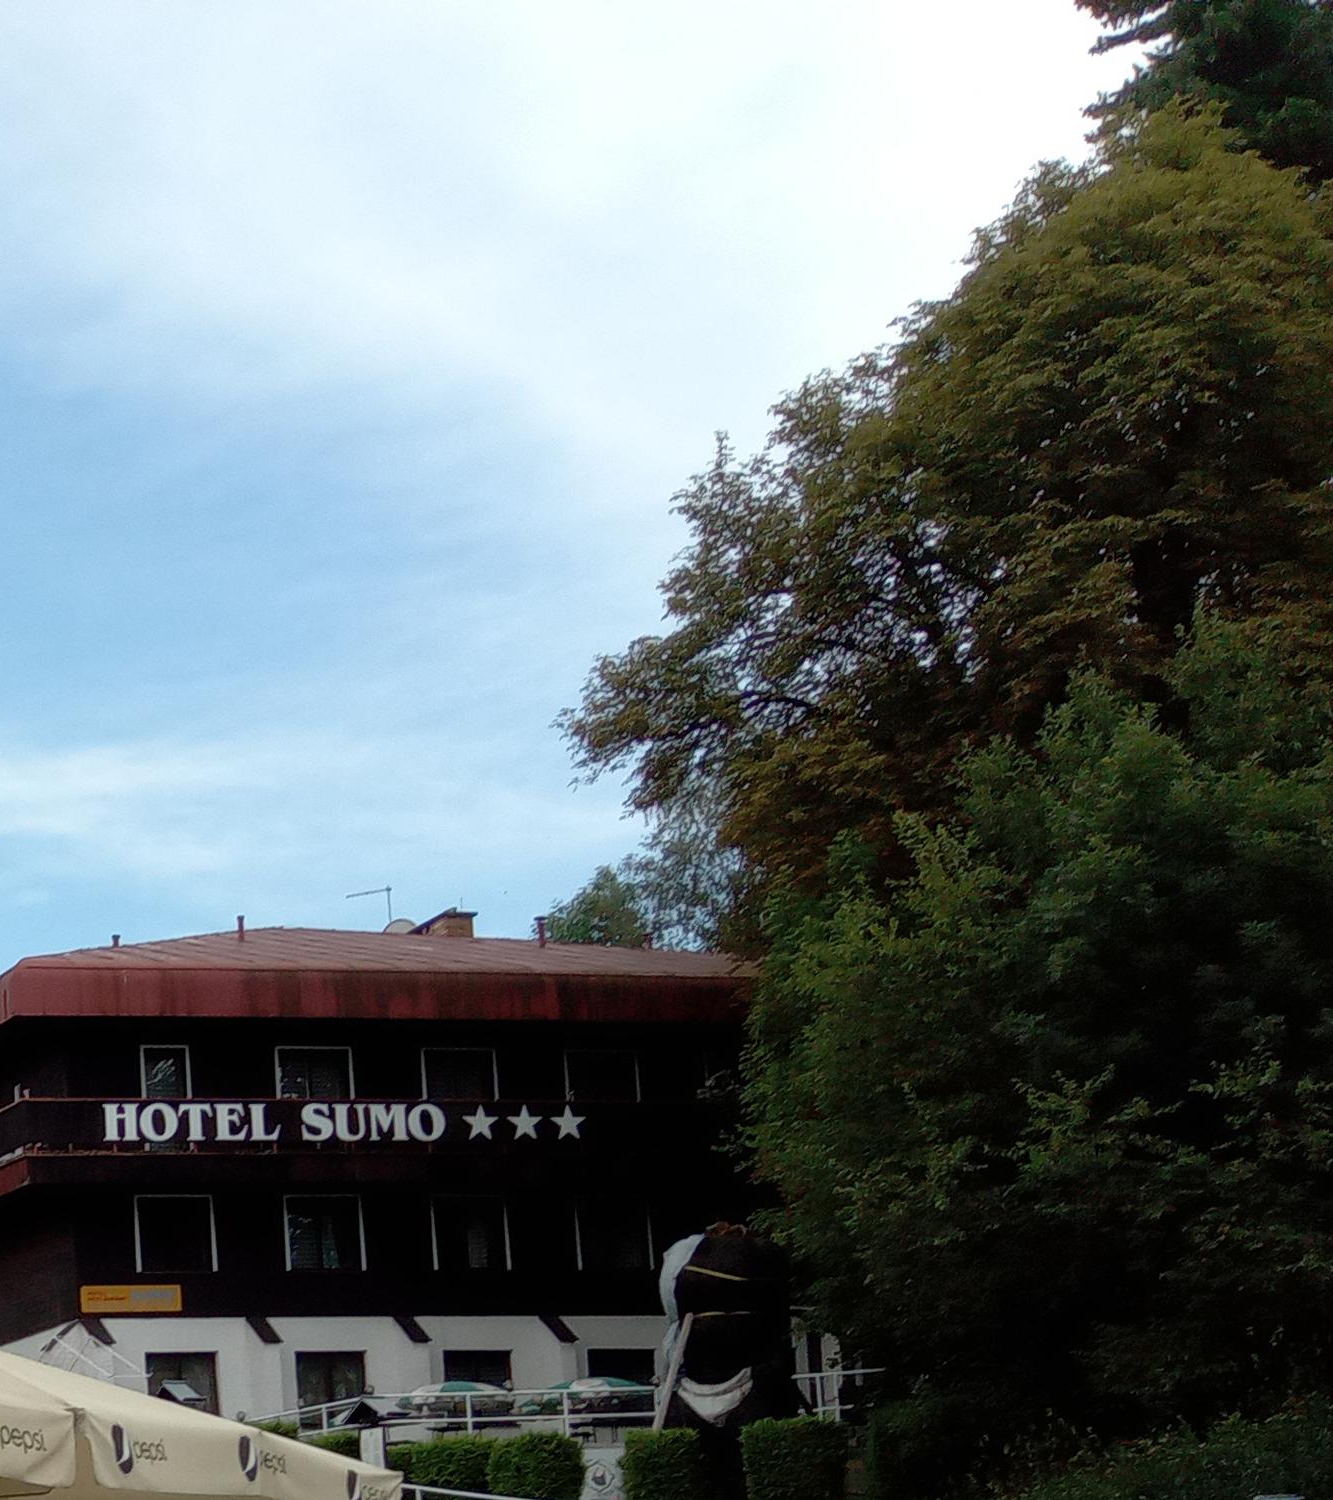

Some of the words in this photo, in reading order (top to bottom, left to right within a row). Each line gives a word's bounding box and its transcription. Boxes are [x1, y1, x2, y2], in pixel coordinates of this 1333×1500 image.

[102, 1102, 282, 1143] HOTEL
[300, 1102, 447, 1143] SUMO
[0, 1424, 45, 1455] pepsi
